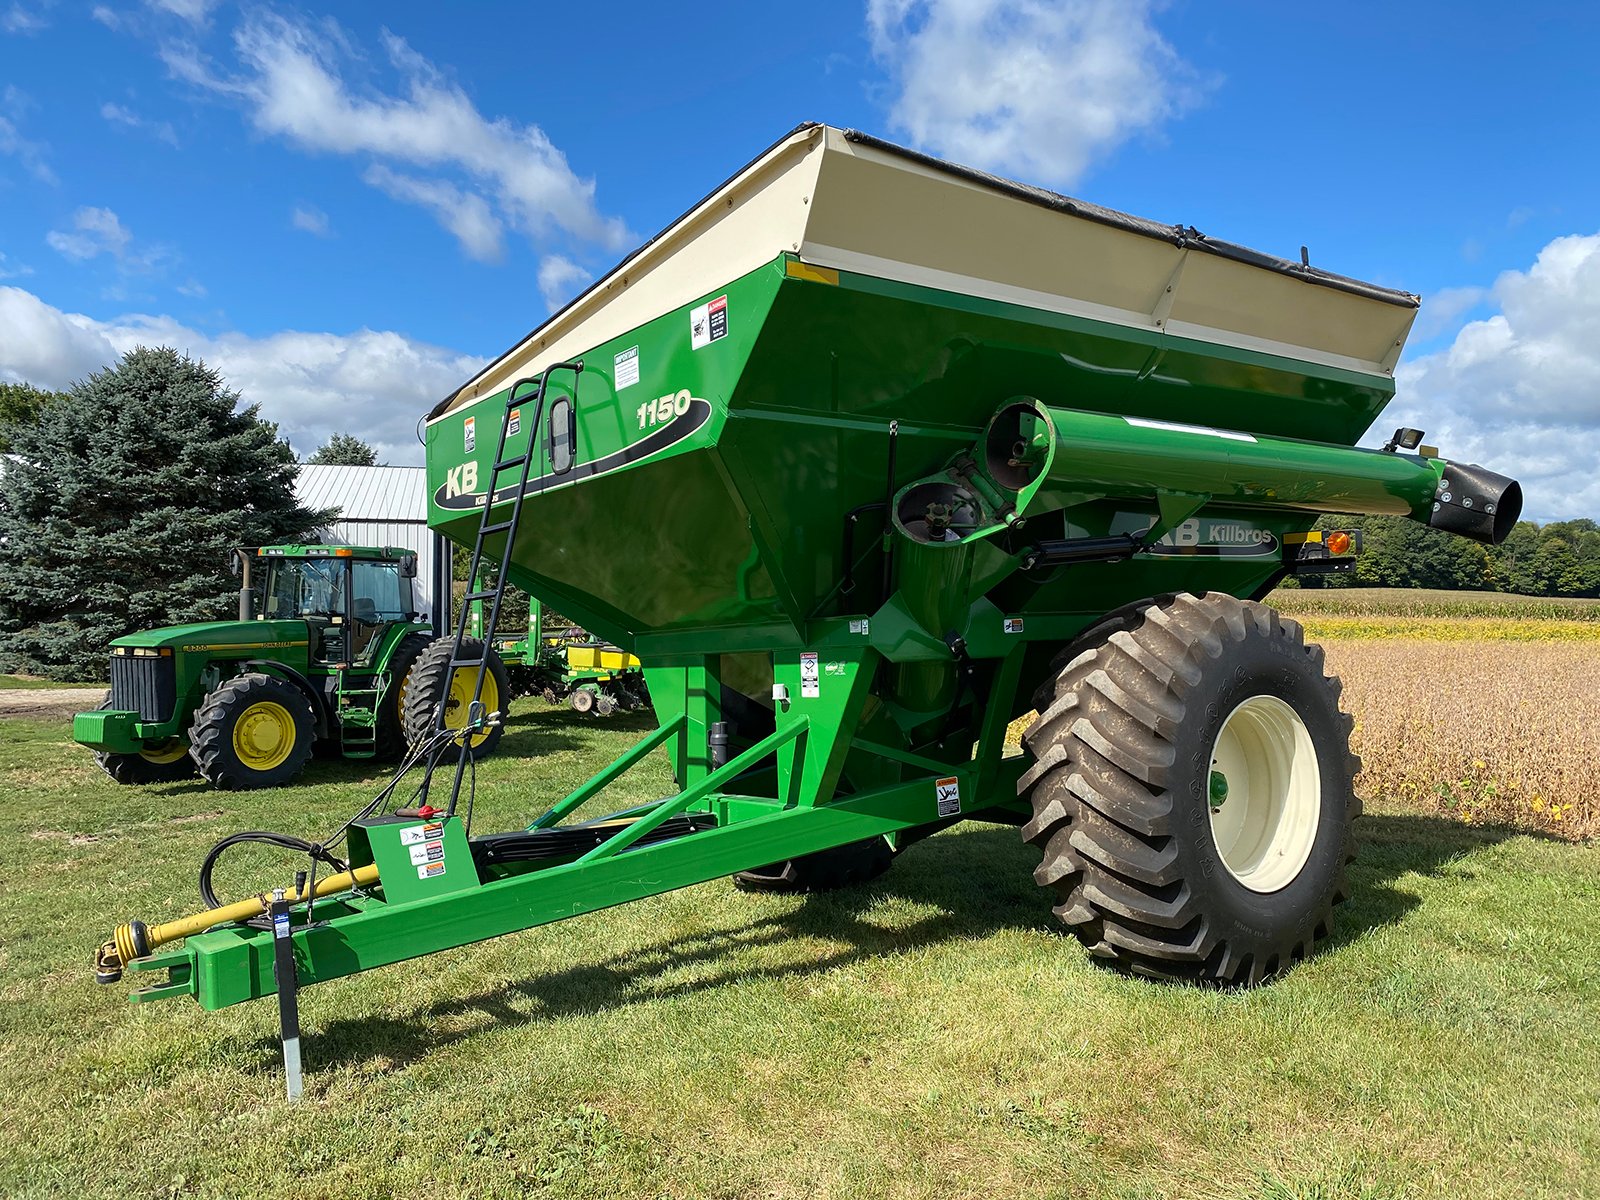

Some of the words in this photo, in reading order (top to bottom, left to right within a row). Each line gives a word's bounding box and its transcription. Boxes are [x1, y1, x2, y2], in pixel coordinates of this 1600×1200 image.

[636, 388, 692, 430] 1150
[446, 460, 478, 499] KB
[1209, 524, 1272, 543] Killbros
